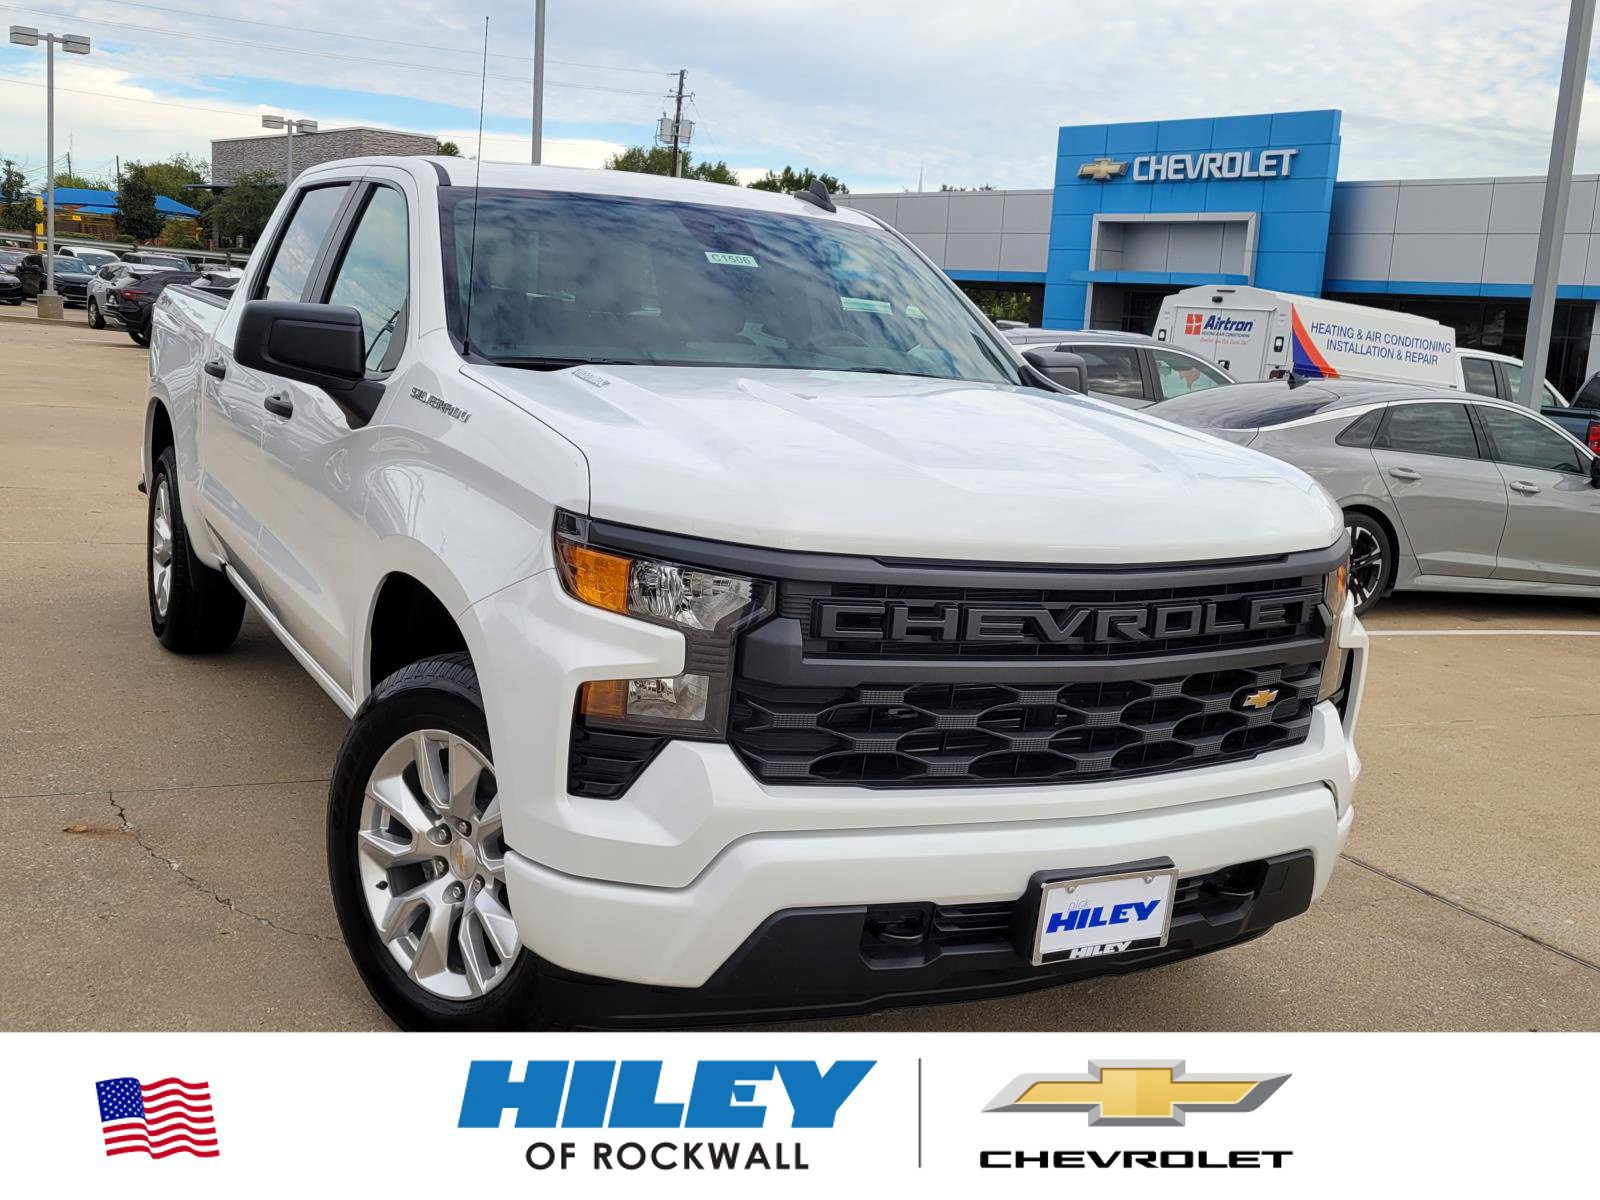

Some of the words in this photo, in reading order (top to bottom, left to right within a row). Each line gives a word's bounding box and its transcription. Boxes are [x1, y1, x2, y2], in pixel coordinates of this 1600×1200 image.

[1133, 149, 1297, 181] CHEVROLET
[711, 253, 752, 264] C1506
[1203, 315, 1254, 332] Airtron
[1311, 322, 1354, 339] HEATING
[1356, 328, 1363, 340] &
[1366, 330, 1382, 343] AIR
[1384, 333, 1452, 354] CONDITIONING
[1326, 339, 1395, 360] INSTALLATION
[1397, 350, 1403, 361] &
[1405, 351, 1439, 365] REPAIR
[815, 592, 1321, 642] CHEVROLET
[1046, 900, 1161, 934] HILEY
[1069, 941, 1132, 960] HILEY
